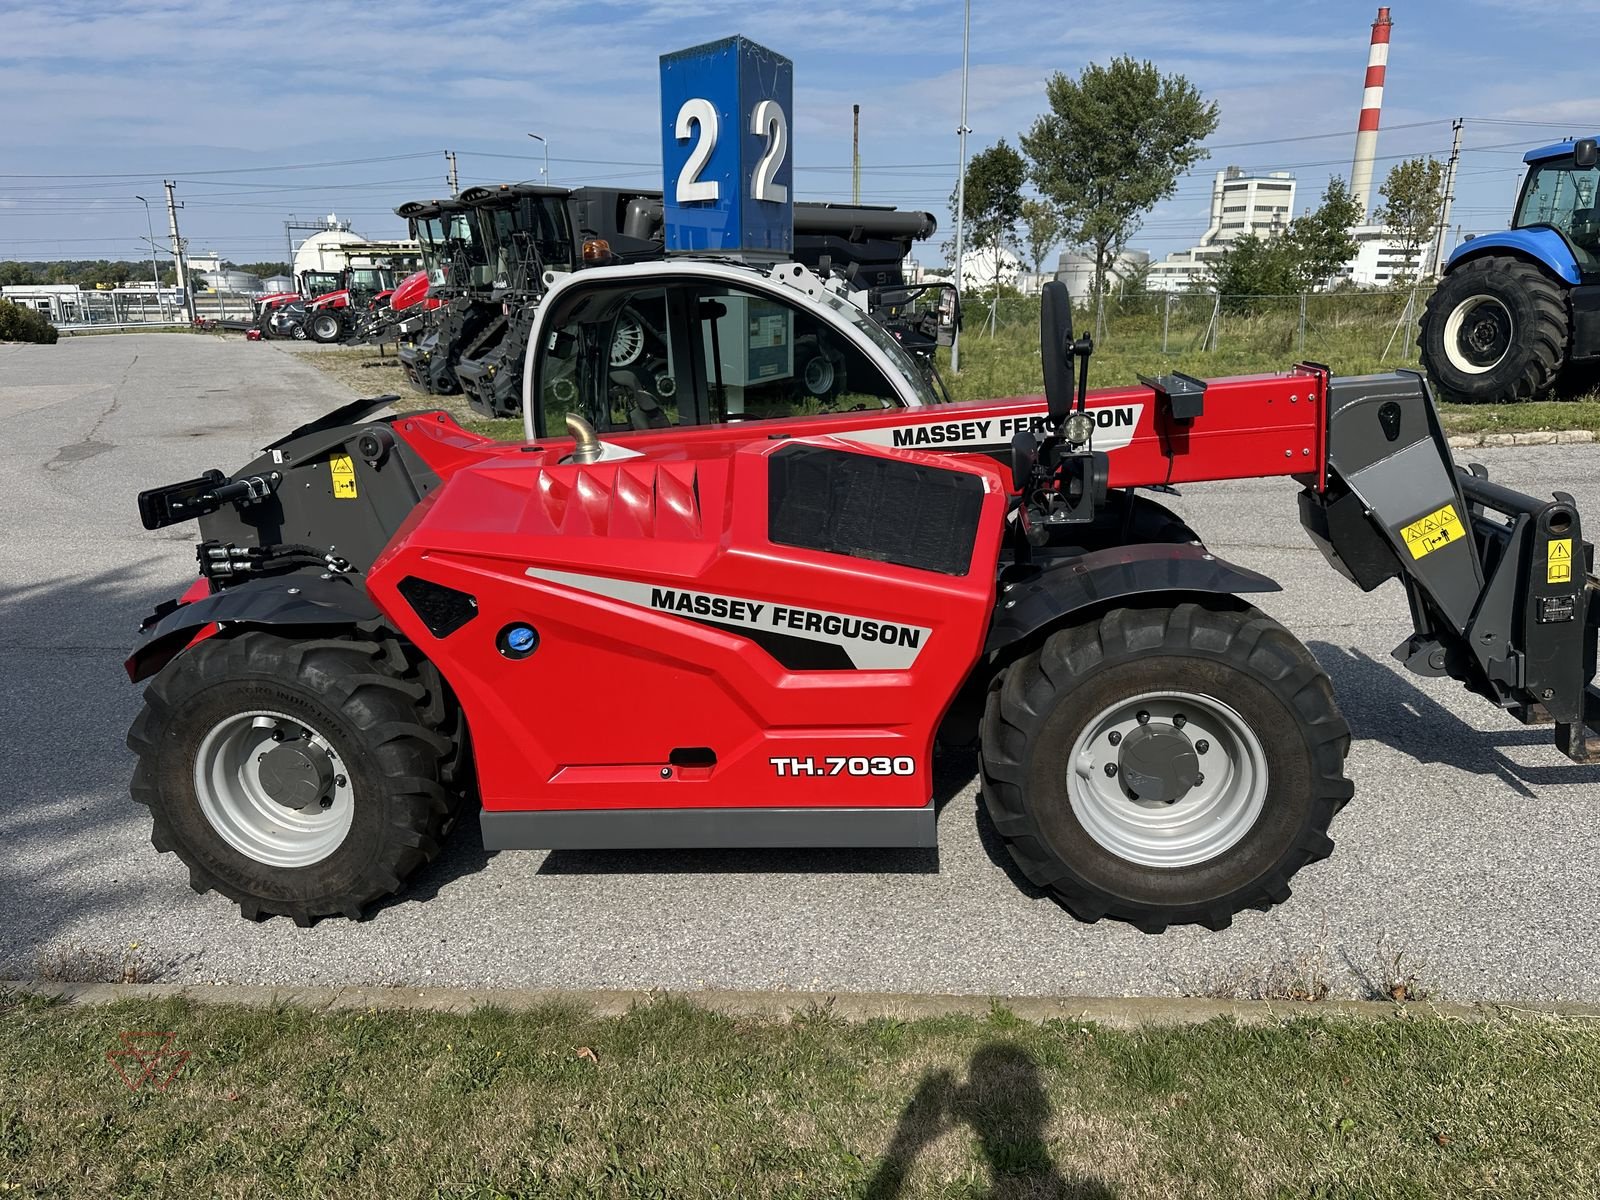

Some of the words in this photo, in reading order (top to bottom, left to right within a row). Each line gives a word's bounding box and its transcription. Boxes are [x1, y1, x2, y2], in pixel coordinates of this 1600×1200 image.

[675, 98, 719, 202] 2
[751, 100, 788, 204] 2
[893, 420, 991, 446] MASSEY
[1000, 407, 1133, 437] FERSON
[651, 588, 764, 622] MASSEY
[772, 606, 920, 649] FERGUSON
[769, 756, 915, 776] TH.7030
